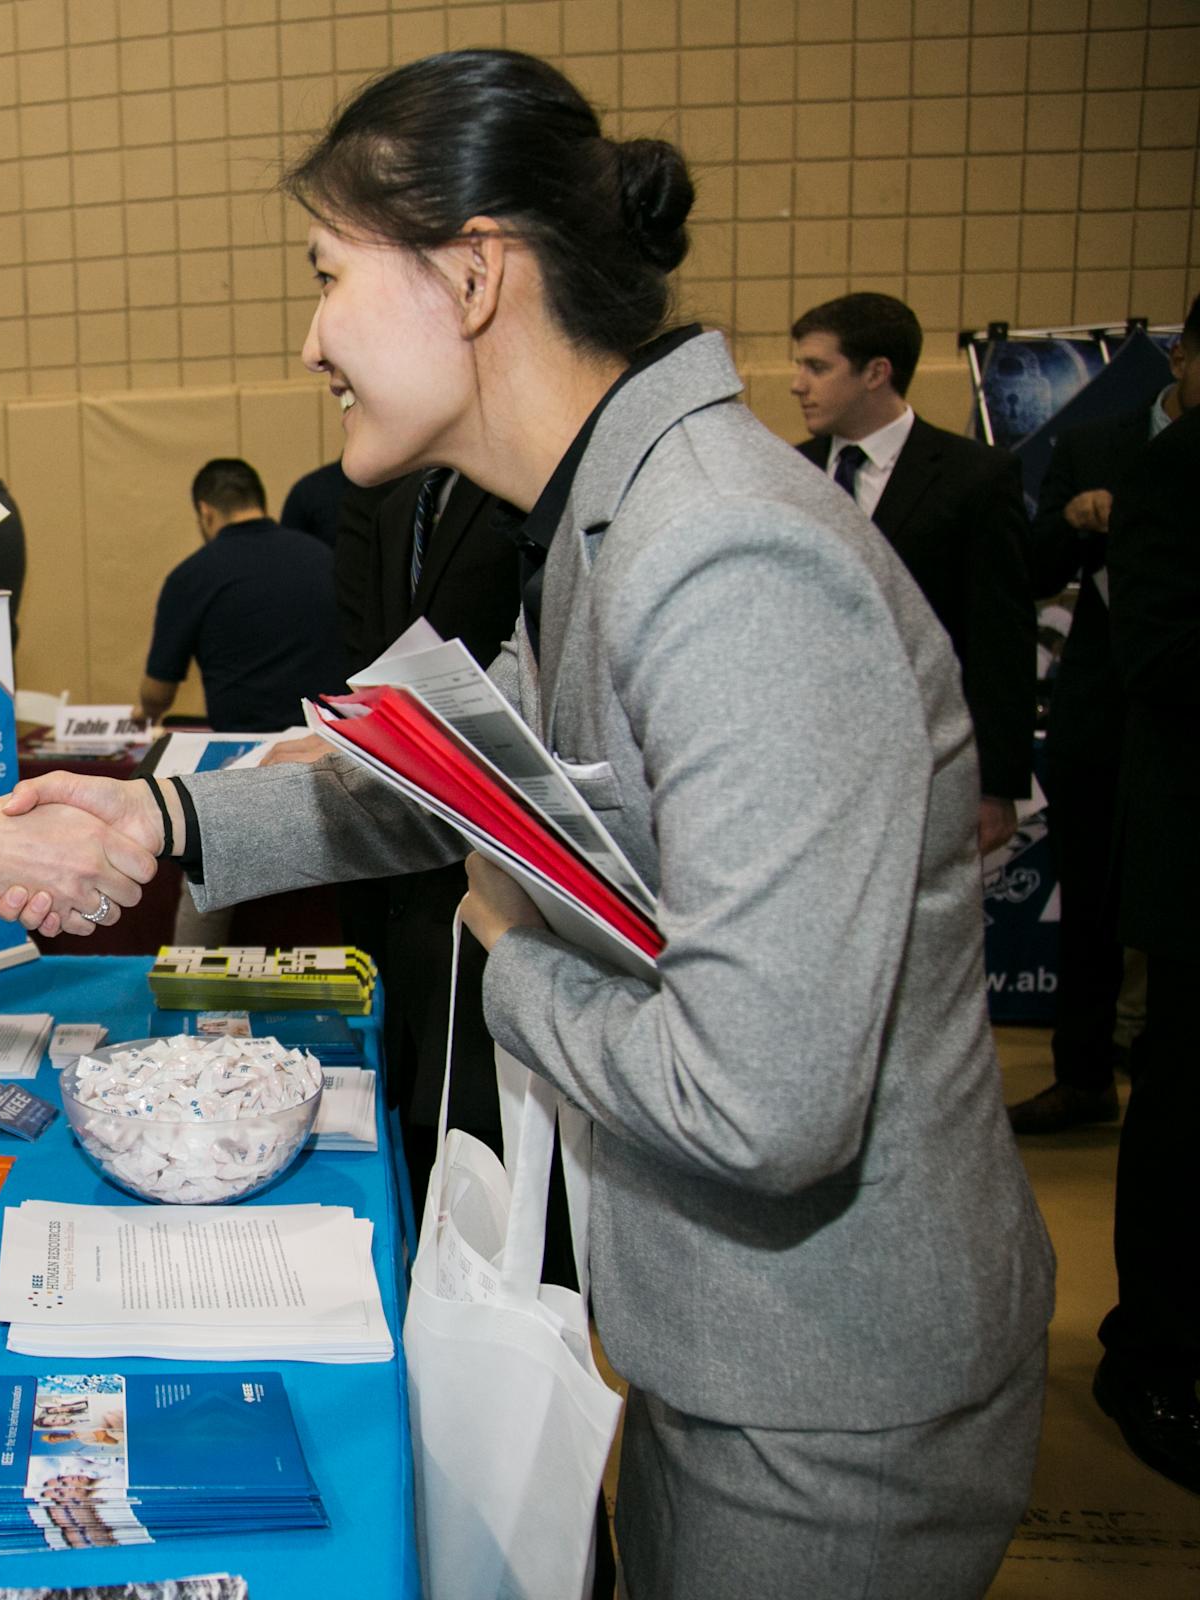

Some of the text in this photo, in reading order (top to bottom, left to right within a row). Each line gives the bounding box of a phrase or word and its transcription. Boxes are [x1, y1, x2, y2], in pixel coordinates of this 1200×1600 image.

[3, 1092, 33, 1117] IEEE
[46, 1221, 61, 1290] HUMAN RESOURCES
[31, 1274, 44, 1289] IEEE
